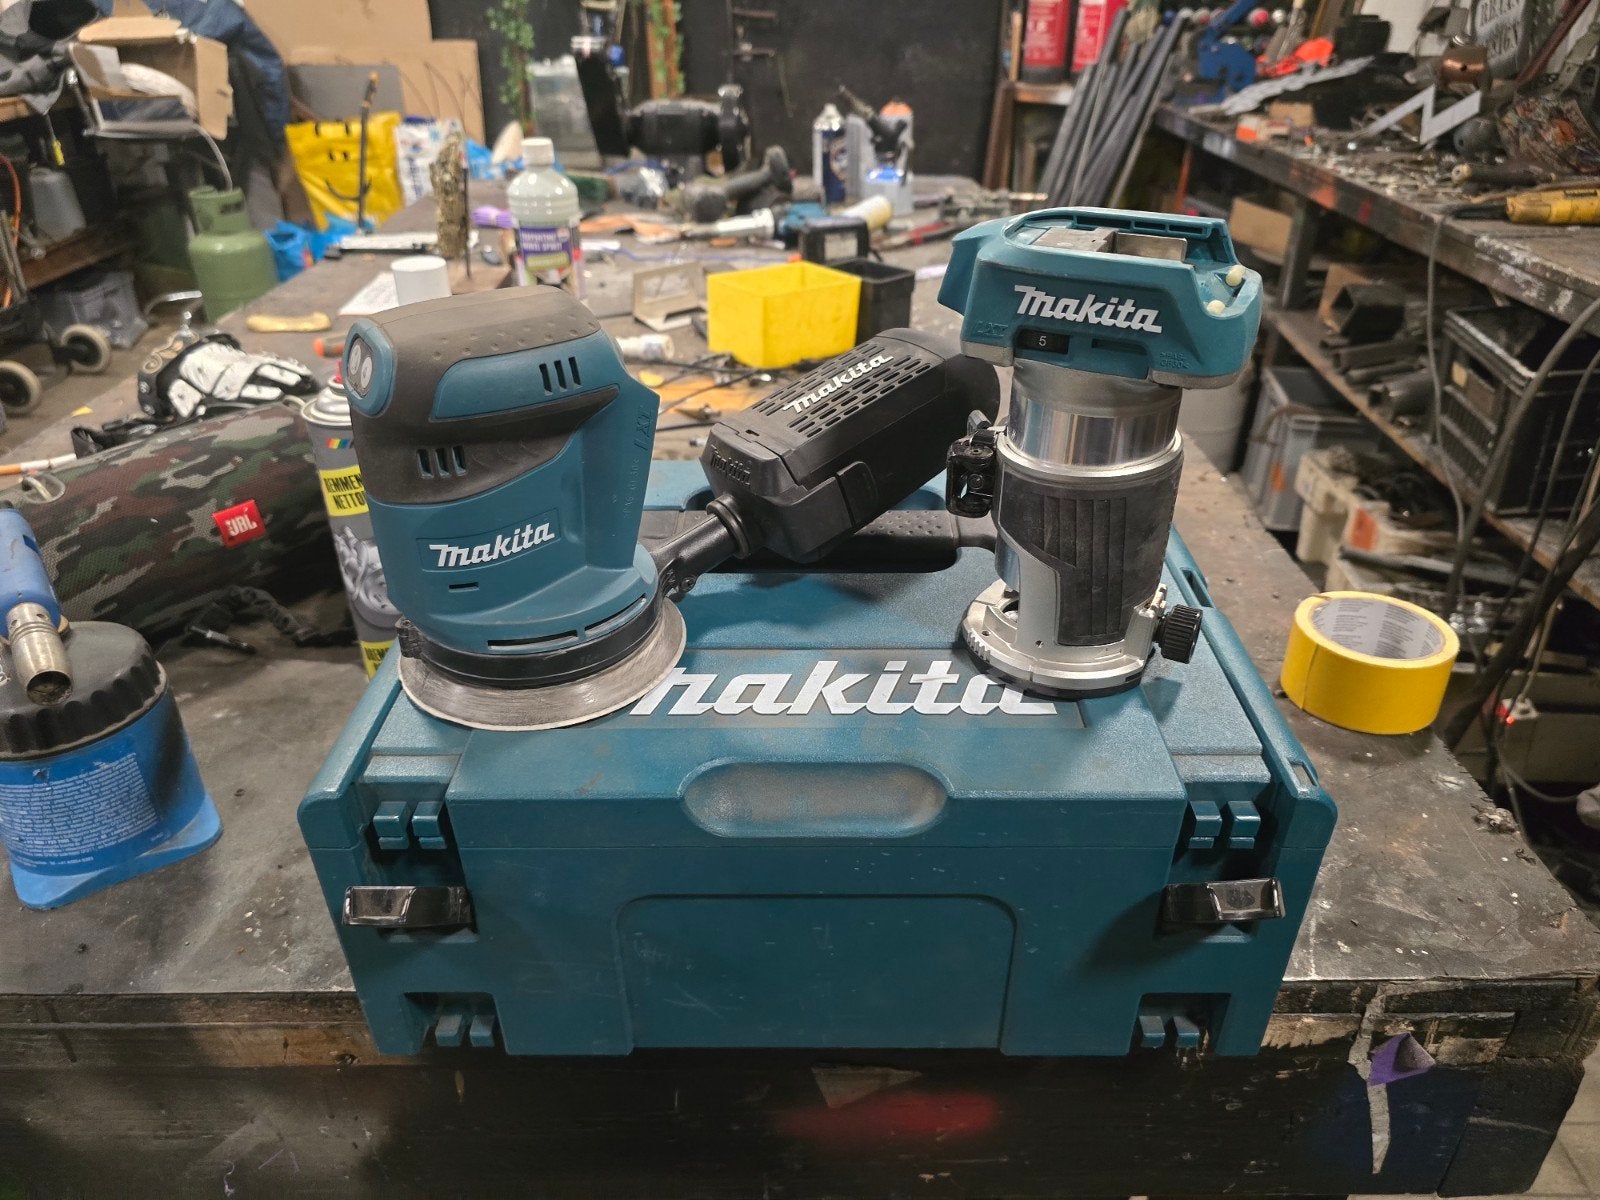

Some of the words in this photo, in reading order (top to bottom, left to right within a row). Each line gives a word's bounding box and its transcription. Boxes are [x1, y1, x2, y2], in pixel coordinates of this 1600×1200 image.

[1038, 336, 1047, 347] 5
[332, 490, 367, 510] NETTO
[224, 508, 258, 537] JBL
